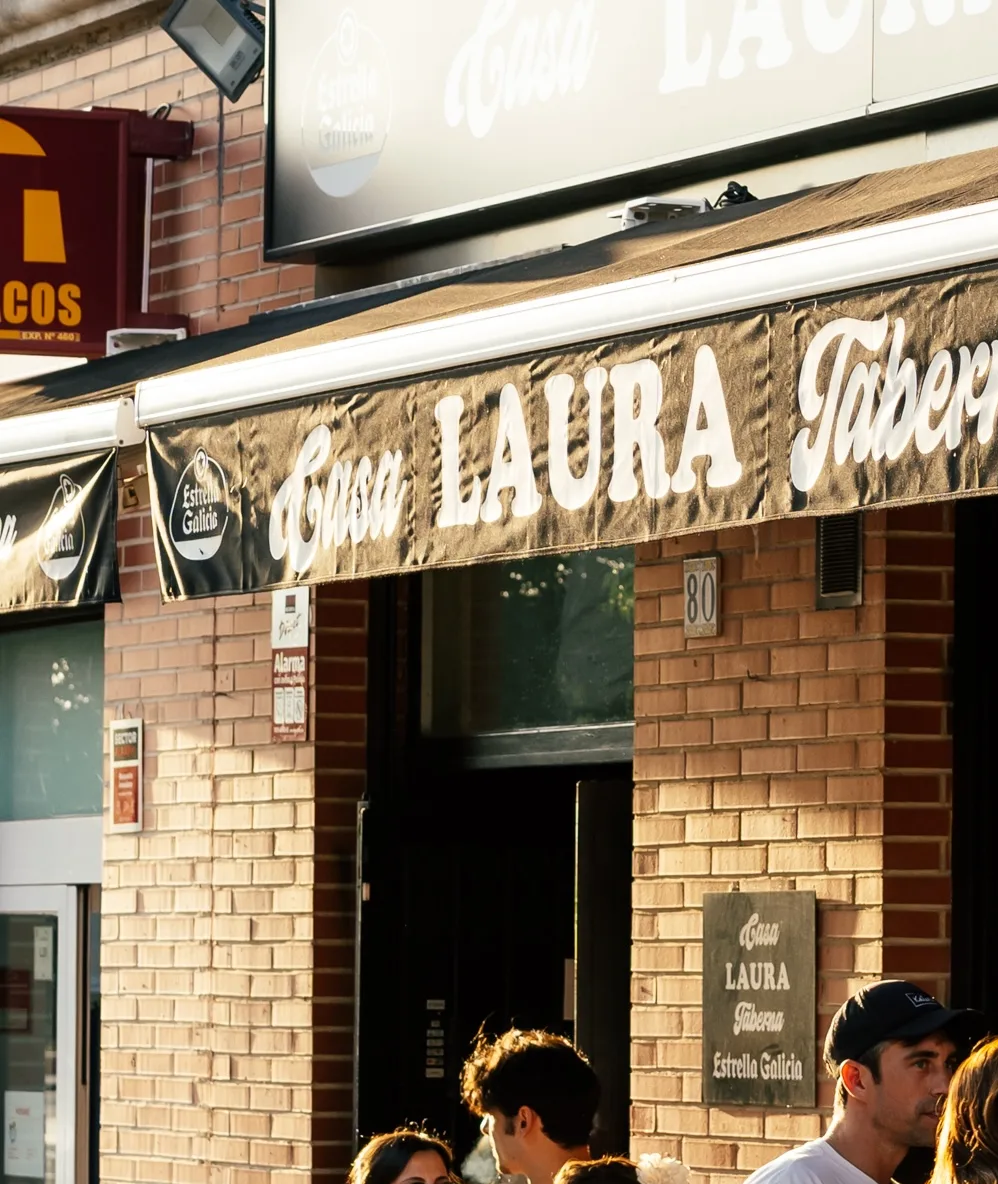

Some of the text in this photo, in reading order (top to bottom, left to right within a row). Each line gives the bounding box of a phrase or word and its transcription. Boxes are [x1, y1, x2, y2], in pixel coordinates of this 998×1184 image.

[443, 0, 600, 139] Casa
[0, 280, 82, 327] COS
[269, 425, 409, 574] Casa
[433, 345, 742, 528] LAURA
[182, 479, 219, 509] Estrella
[182, 505, 218, 535] Galicia
[687, 572, 715, 624] 80
[274, 652, 305, 673] Alarma
[739, 912, 781, 951] Casa
[725, 961, 791, 991] LAURA
[733, 1001, 786, 1036] Taberna
[712, 1051, 804, 1081] Estrella Galicia
